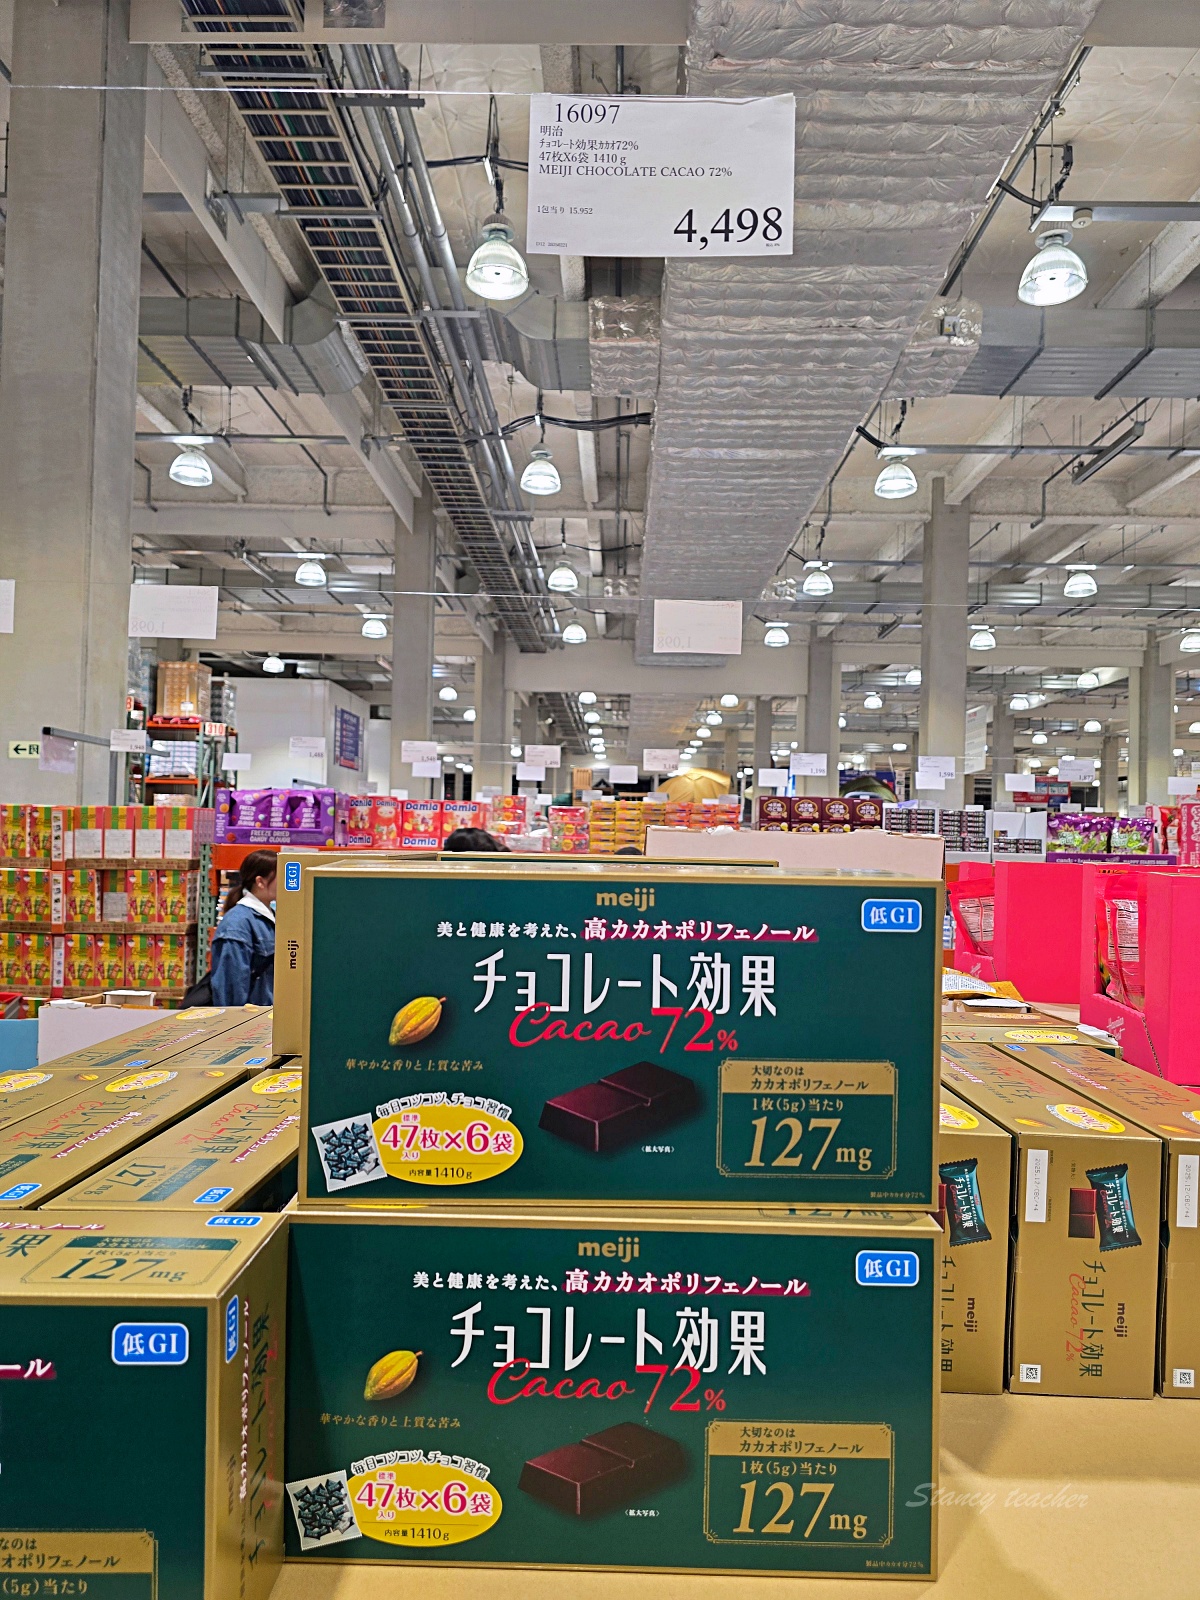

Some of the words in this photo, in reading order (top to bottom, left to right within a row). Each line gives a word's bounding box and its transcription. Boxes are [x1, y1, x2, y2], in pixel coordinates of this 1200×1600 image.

[554, 103, 621, 124] 16097
[539, 125, 564, 137] 明治
[539, 164, 573, 177] MEIJI
[576, 165, 657, 177] CHOCOLATE
[660, 166, 705, 178] CACAO
[708, 166, 733, 177] 72%
[673, 206, 783, 250] 4,498
[207, 723, 224, 736] 310
[405, 802, 438, 811] Damla
[444, 803, 477, 812] Damla
[250, 829, 271, 837] FREEZE
[403, 837, 437, 846] Damla
[287, 865, 298, 888] 低GI
[596, 887, 656, 912] meiji
[868, 906, 915, 925] 低GI
[287, 939, 298, 970] meiji
[473, 947, 777, 1017] チョコレート効果
[508, 1002, 652, 1048] Cacao
[651, 1006, 739, 1054] 72%
[345, 1057, 484, 1072] 華やかな香りと上質な苦み
[751, 1064, 805, 1077] 大切なのは
[751, 1078, 870, 1092] カカオポリフェノール
[401, 1150, 420, 1160] 入り
[577, 1236, 641, 1263] meiji
[864, 1257, 911, 1279] 低GI
[1069, 1273, 1087, 1329] Cacao
[964, 1297, 978, 1333] meiji
[1079, 1260, 1107, 1377] チョコレート効果
[1114, 1302, 1128, 1338] meiji
[121, 1332, 179, 1356] 低GI
[450, 1301, 767, 1376] チョコレート効果
[1065, 1327, 1085, 1362] 72%
[487, 1357, 635, 1406] Cacao
[635, 1364, 727, 1413] 72%
[319, 1412, 461, 1429] 華やかな香りと上質な苦み
[739, 1426, 796, 1438] 大切なのは
[739, 1439, 864, 1454] カカオポリフェノール
[376, 1510, 395, 1520] 入り
